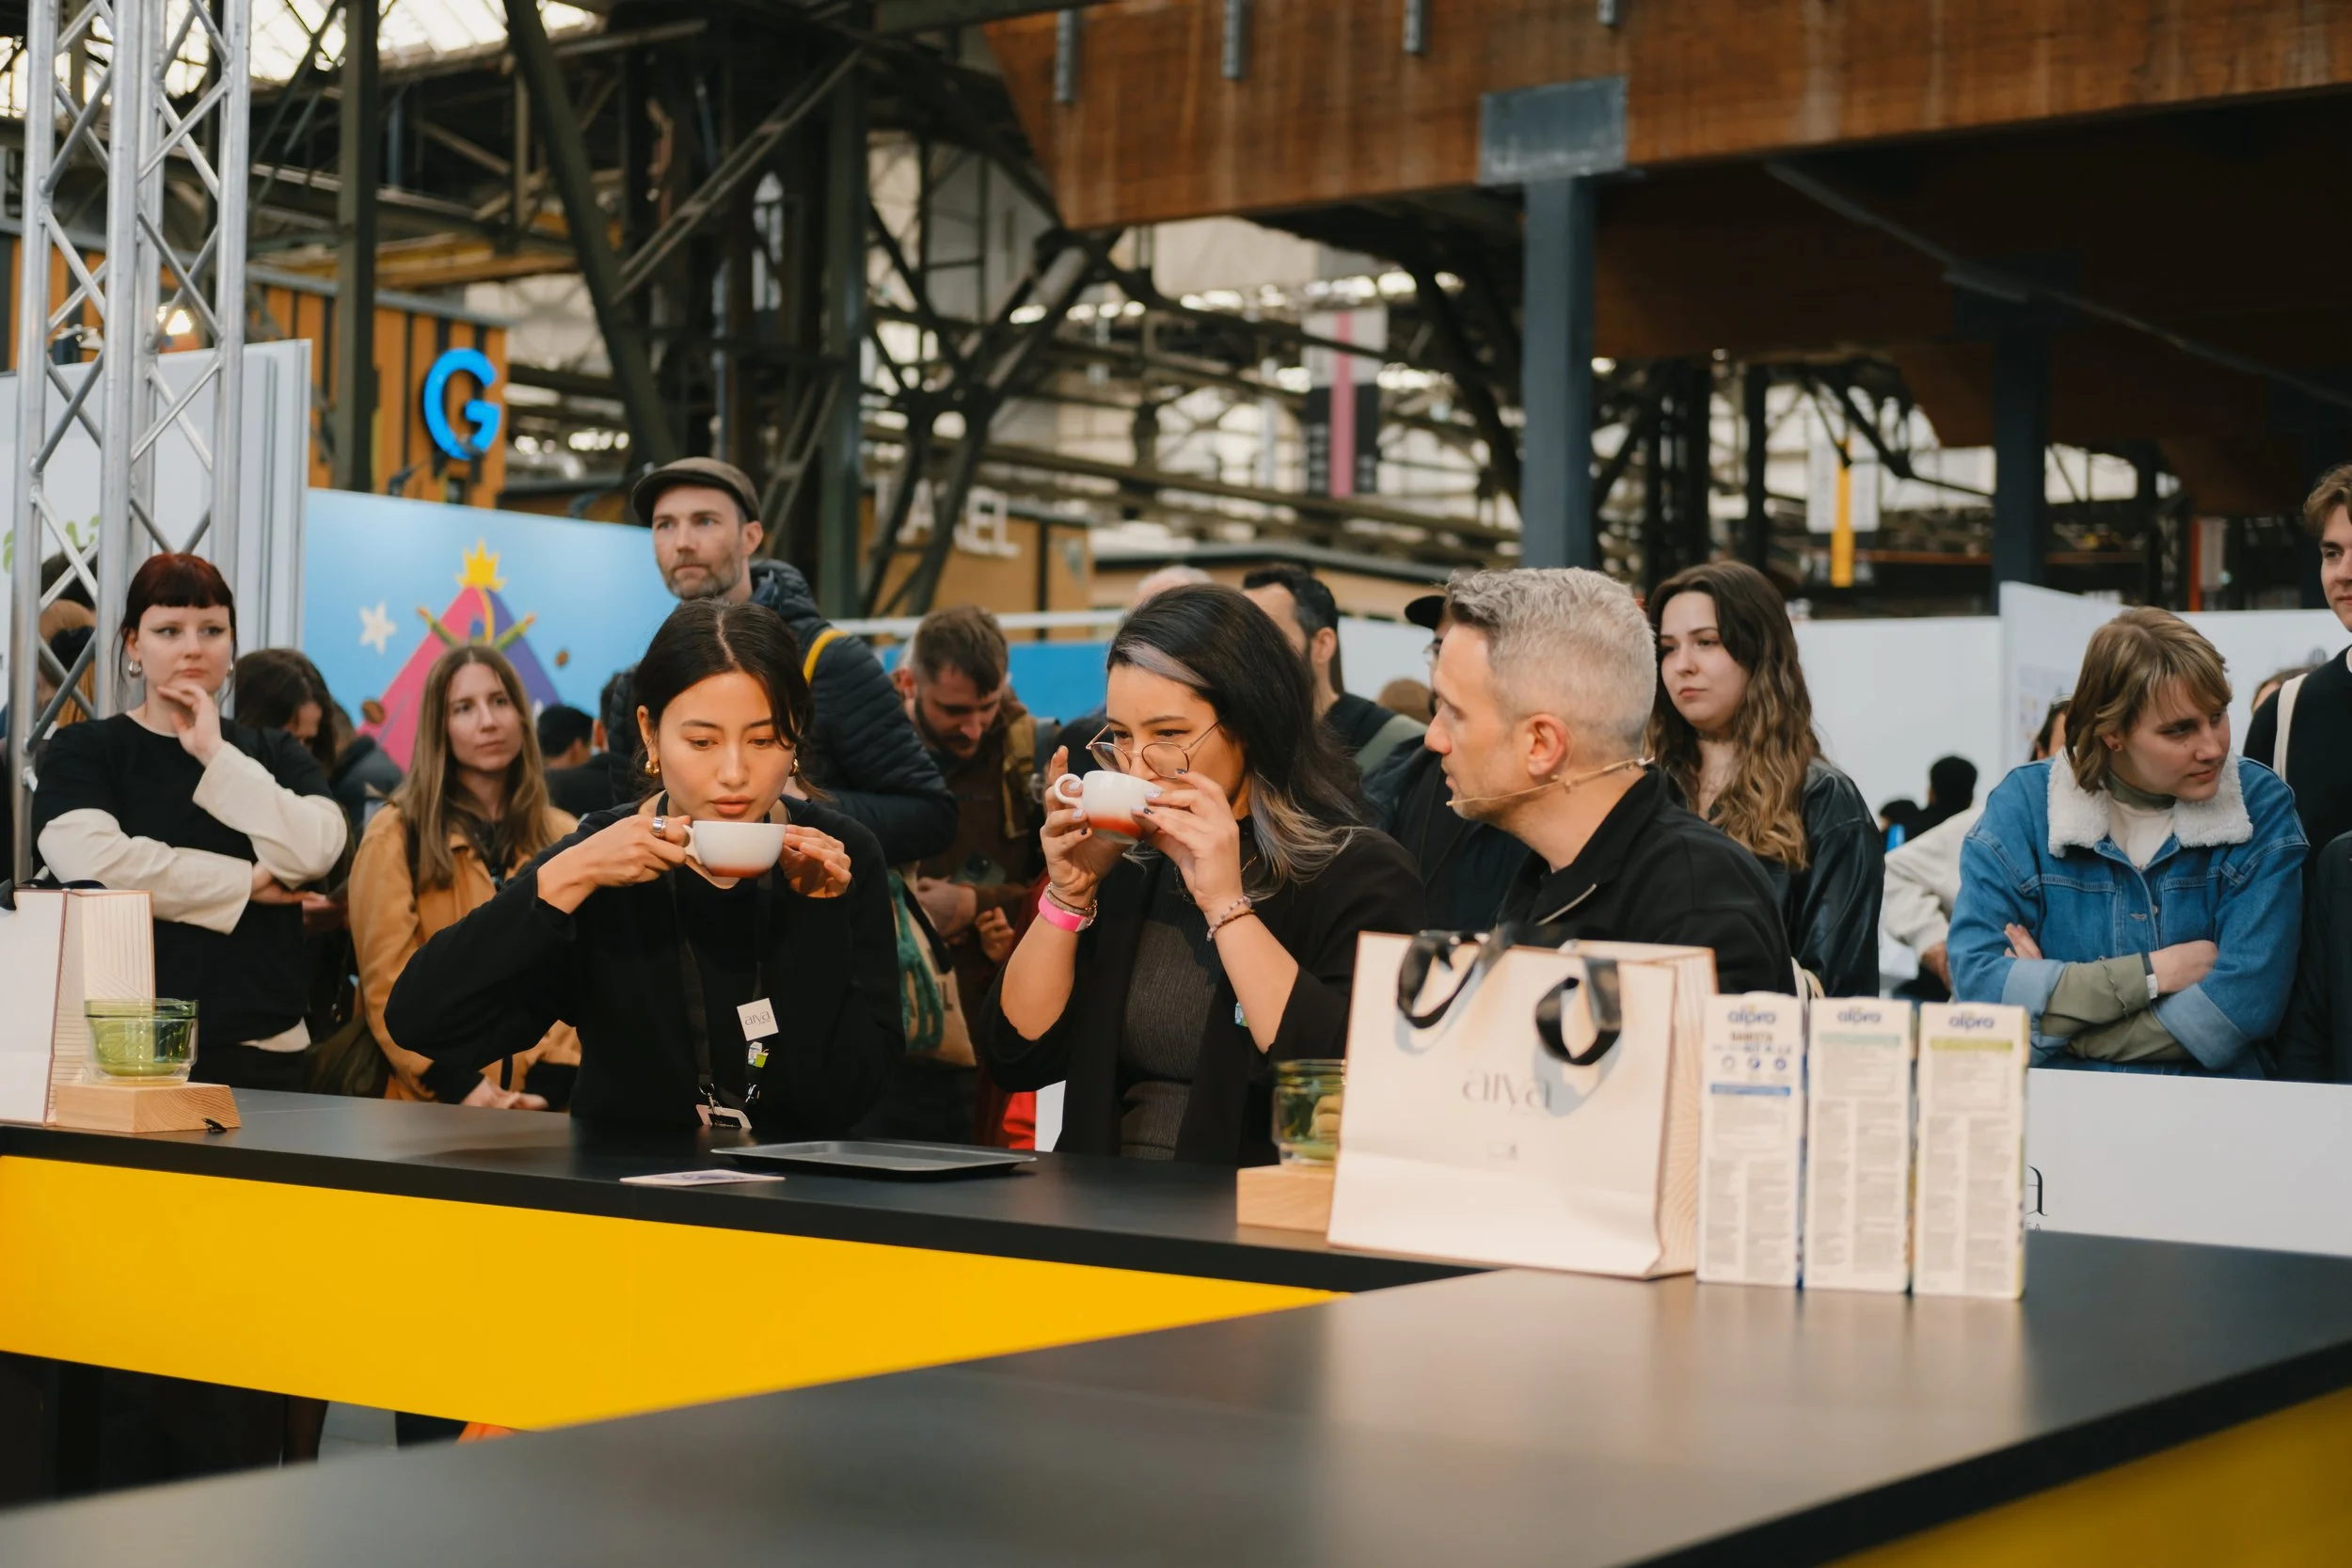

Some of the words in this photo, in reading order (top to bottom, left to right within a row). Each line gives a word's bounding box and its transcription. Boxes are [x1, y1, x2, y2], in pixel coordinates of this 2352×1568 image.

[1727, 1004, 1776, 1027] alpro
[1837, 1006, 1883, 1026] alpro
[1948, 1010, 1995, 1031] alpro
